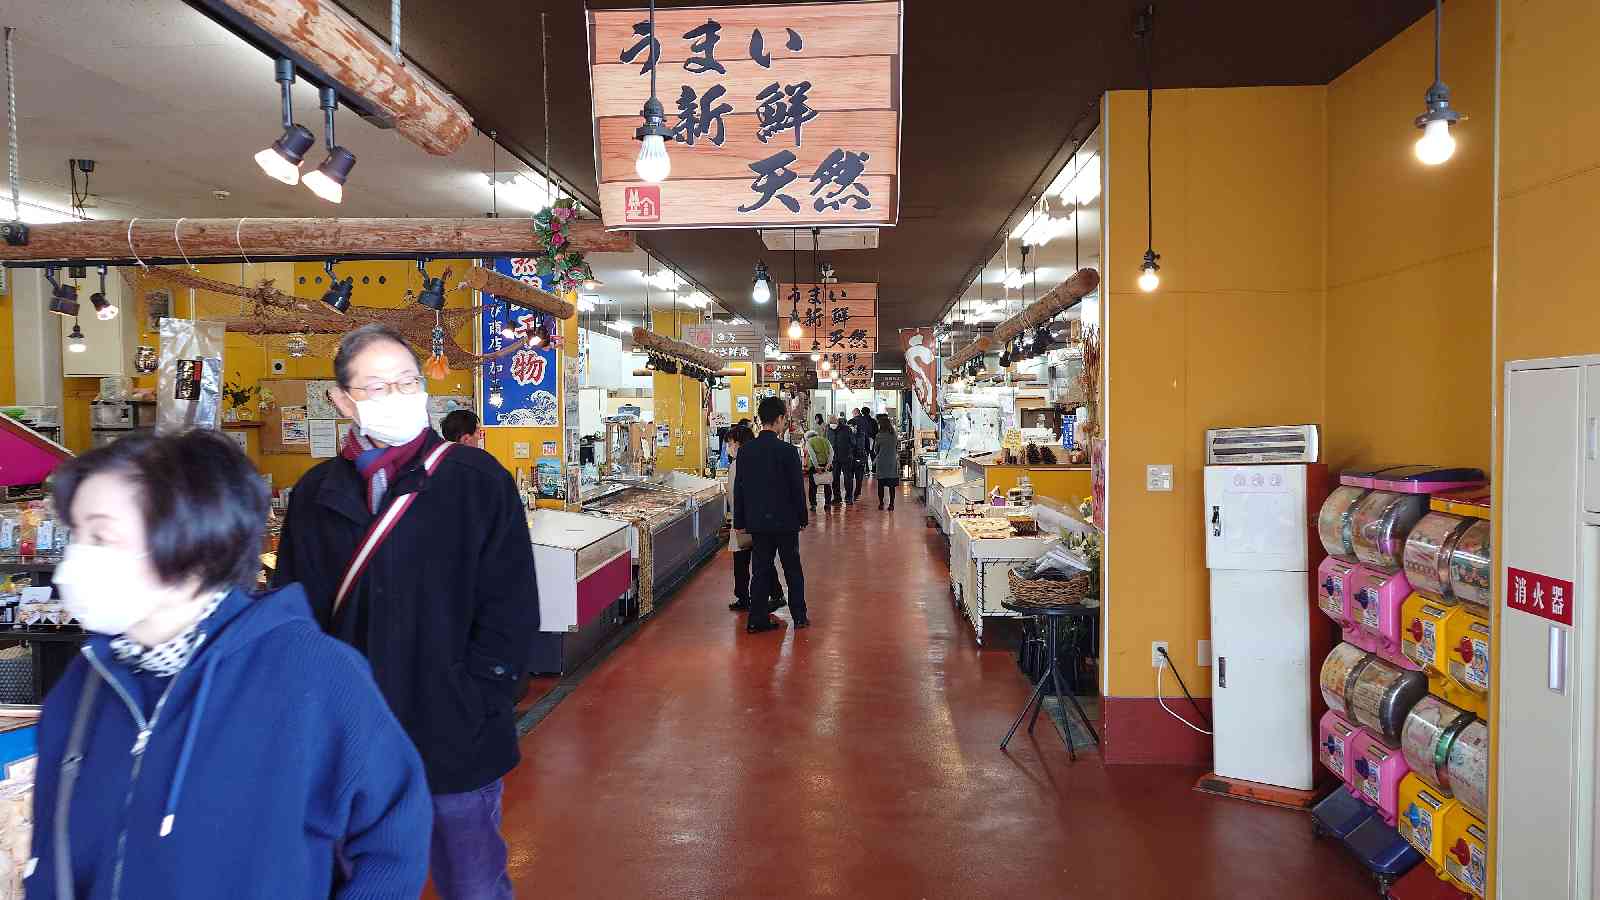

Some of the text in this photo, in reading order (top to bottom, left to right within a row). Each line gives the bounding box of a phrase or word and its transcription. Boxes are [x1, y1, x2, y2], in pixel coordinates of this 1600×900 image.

[619, 18, 803, 75] うまい
[672, 80, 819, 147] 新鮮
[737, 148, 872, 214] 天然
[788, 286, 848, 304] うまい
[802, 306, 849, 328] 新鮮
[825, 328, 869, 349] 天然
[1514, 576, 1564, 616] 消火器
